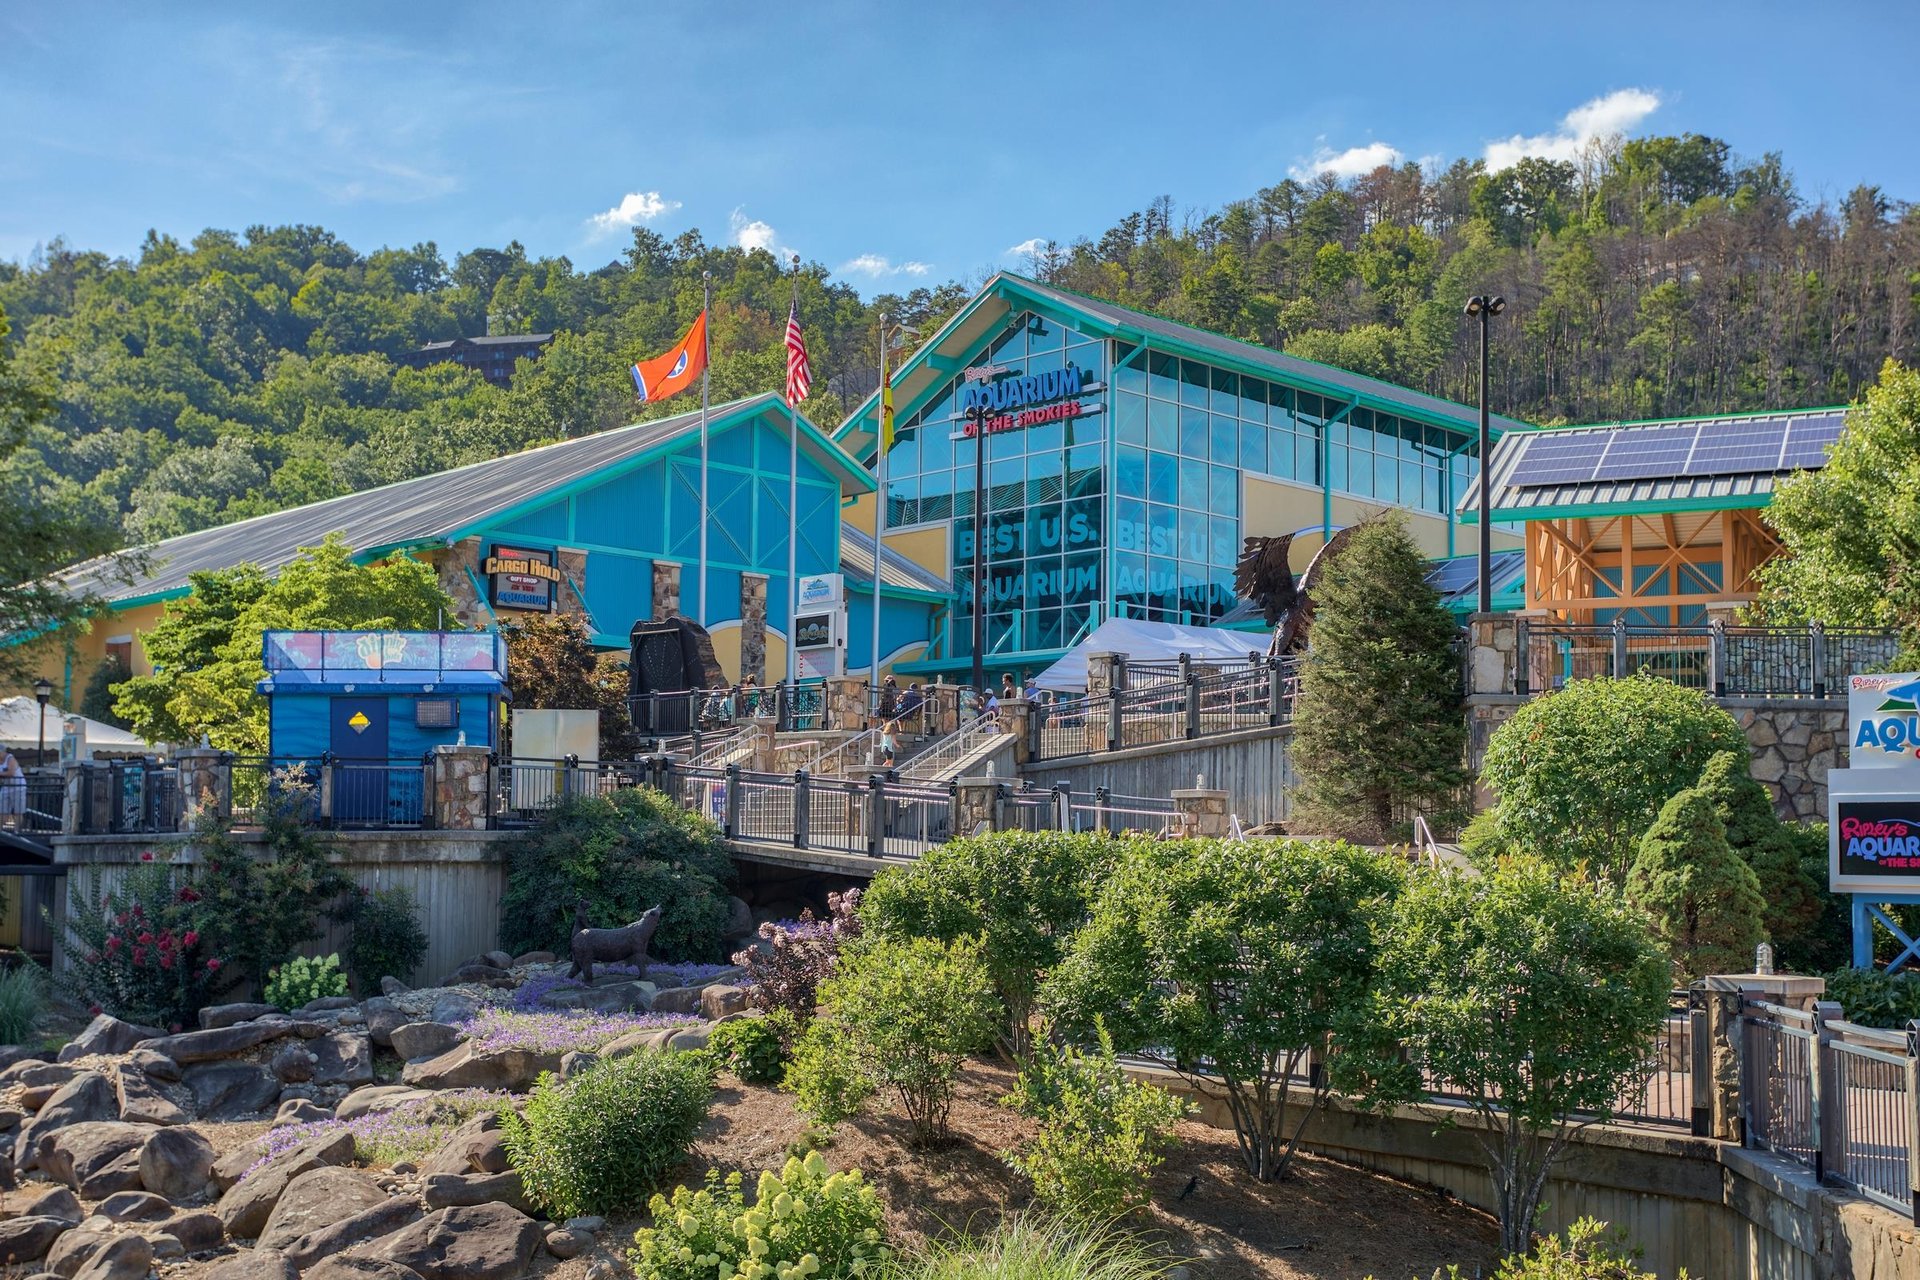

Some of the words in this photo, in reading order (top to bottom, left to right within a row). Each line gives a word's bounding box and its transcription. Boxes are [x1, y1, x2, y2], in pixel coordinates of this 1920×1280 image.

[962, 366, 1080, 415] AQUARIUM
[986, 415, 1014, 432] THE
[1017, 401, 1082, 427] SMOKIES
[960, 522, 1032, 559] BEST
[1117, 519, 1183, 557] BEST
[485, 557, 528, 574] CARGO
[529, 558, 561, 583] HOLD
[498, 592, 547, 605] AQUARIUM
[960, 565, 1097, 606] AQUARIUM
[1841, 817, 1908, 842] Ripley's
[1846, 835, 1920, 861] AQUAR
[1887, 857, 1908, 868] THE
